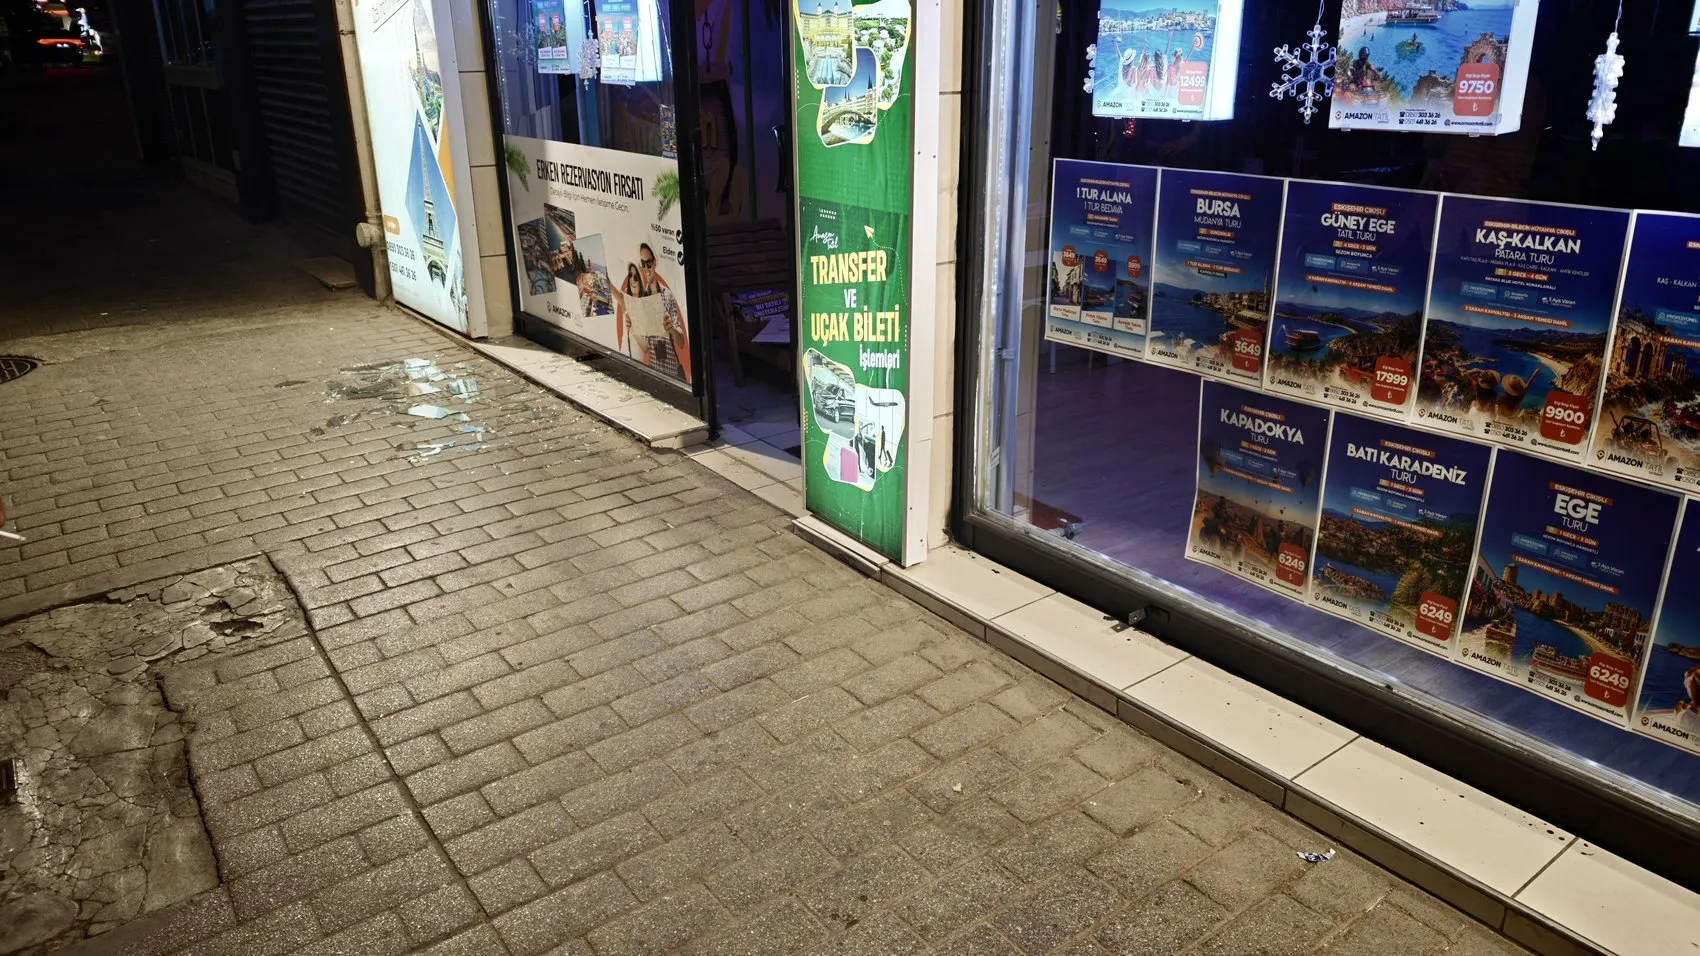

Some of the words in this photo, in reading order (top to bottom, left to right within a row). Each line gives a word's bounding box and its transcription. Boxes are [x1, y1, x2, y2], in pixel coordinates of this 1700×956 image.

[1180, 76, 1206, 87] 12499
[1459, 80, 1494, 94] 9750
[1344, 112, 1373, 120] AMAZON
[536, 159, 559, 182] ERKEN
[560, 164, 612, 194] REZERVASYON
[614, 173, 644, 200] FIRSATI
[1081, 188, 1098, 200] TUR
[1100, 190, 1132, 204] ALANA
[1088, 202, 1100, 212] TUR
[1101, 203, 1123, 214] BEDAVA
[1196, 198, 1240, 218] BURSA
[1194, 216, 1223, 226] MUDANYA
[1226, 219, 1241, 229] TURU
[1321, 212, 1367, 230] GÜNEY
[1369, 218, 1396, 234] EGE
[1356, 230, 1376, 242] TURU
[1476, 228, 1581, 254] KAŞ-KALKAN
[1495, 249, 1526, 262] PATARA
[1530, 252, 1554, 264] TURU
[810, 250, 887, 284] TRANSFER
[1657, 277, 1668, 286] KAŞ
[1673, 280, 1697, 288] KALKAN
[844, 289, 856, 308] VE
[810, 312, 849, 346] UÇAK
[854, 304, 900, 342] BİLETİ
[1055, 327, 1072, 336] AMAZON
[1158, 349, 1178, 359] AMAZON
[1234, 340, 1261, 356] 3649
[860, 344, 900, 371] İşlemleri
[1278, 379, 1301, 389] AMAZON
[1376, 370, 1408, 386] 17999
[1428, 411, 1457, 424] AMAZON
[1546, 406, 1584, 424] 9900
[1220, 408, 1304, 444] KAPADOKYA
[1251, 433, 1269, 445] TURU
[1347, 443, 1377, 462] BATI
[1380, 451, 1467, 485] KARADENİZ
[1608, 454, 1643, 468] AMAZON
[1391, 469, 1416, 484] TURU
[1554, 493, 1602, 524] EGE
[1562, 516, 1588, 532] TURU
[1200, 548, 1221, 560] AMAZON
[1279, 553, 1305, 570] 6249
[1323, 596, 1348, 609] AMAZON
[1420, 604, 1452, 623] 6249
[1471, 652, 1501, 668] AMAZON
[1590, 665, 1630, 689] 6249
[1652, 720, 1689, 740] AMAZON
